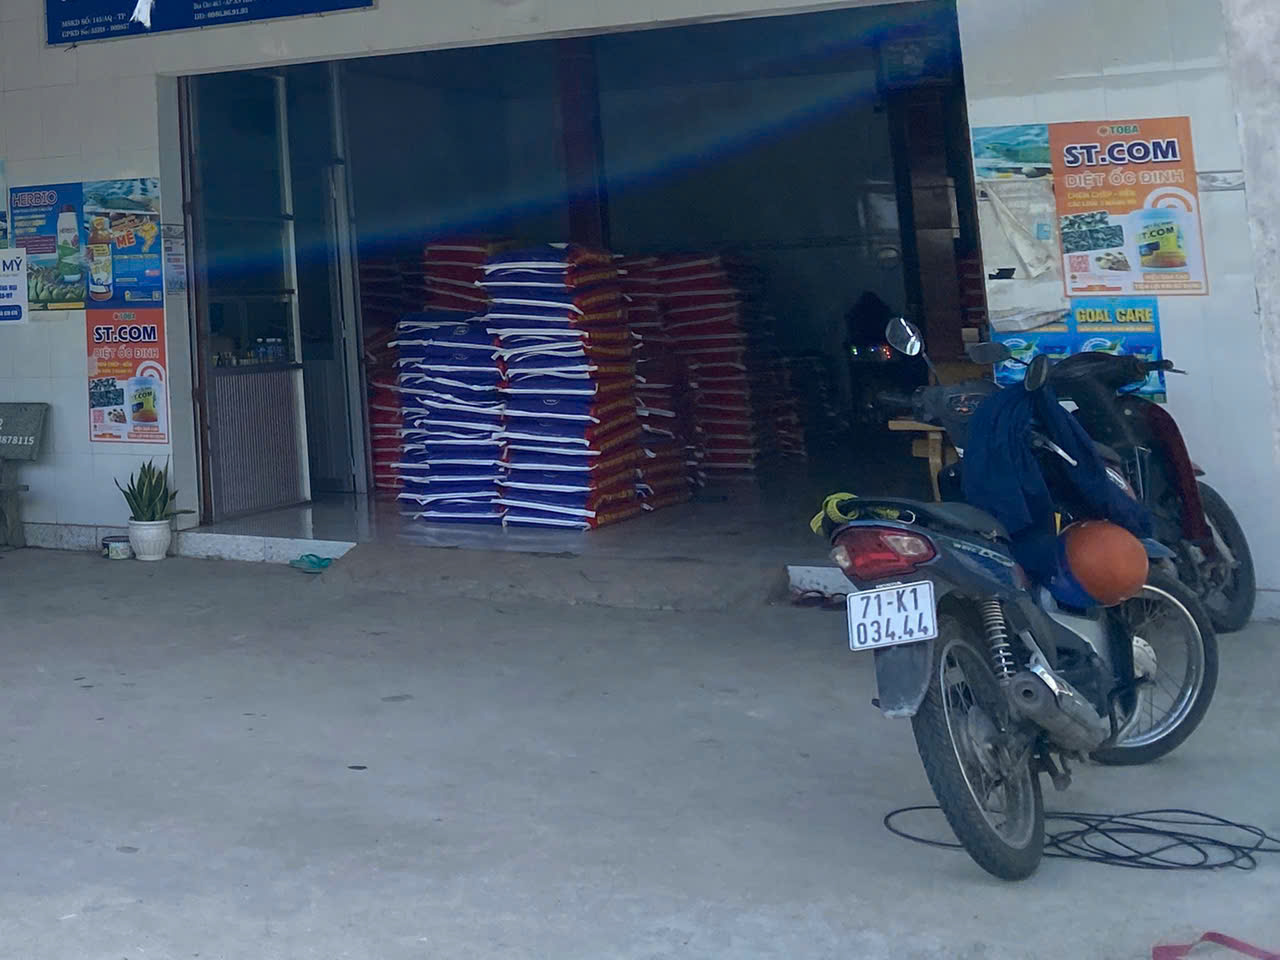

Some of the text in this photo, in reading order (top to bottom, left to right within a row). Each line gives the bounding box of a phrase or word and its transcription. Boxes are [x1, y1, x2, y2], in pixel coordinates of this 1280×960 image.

[1064, 138, 1180, 166] ST.COM
[1066, 167, 1185, 189] DIỆT ỐC ĐINH
[12, 190, 57, 207] HERBIO
[2, 256, 23, 272] MỸ
[1076, 308, 1154, 324] GOAL CARE
[94, 325, 158, 343] ST.COM
[861, 588, 920, 620] 71-K1
[857, 613, 930, 646] 034.44
